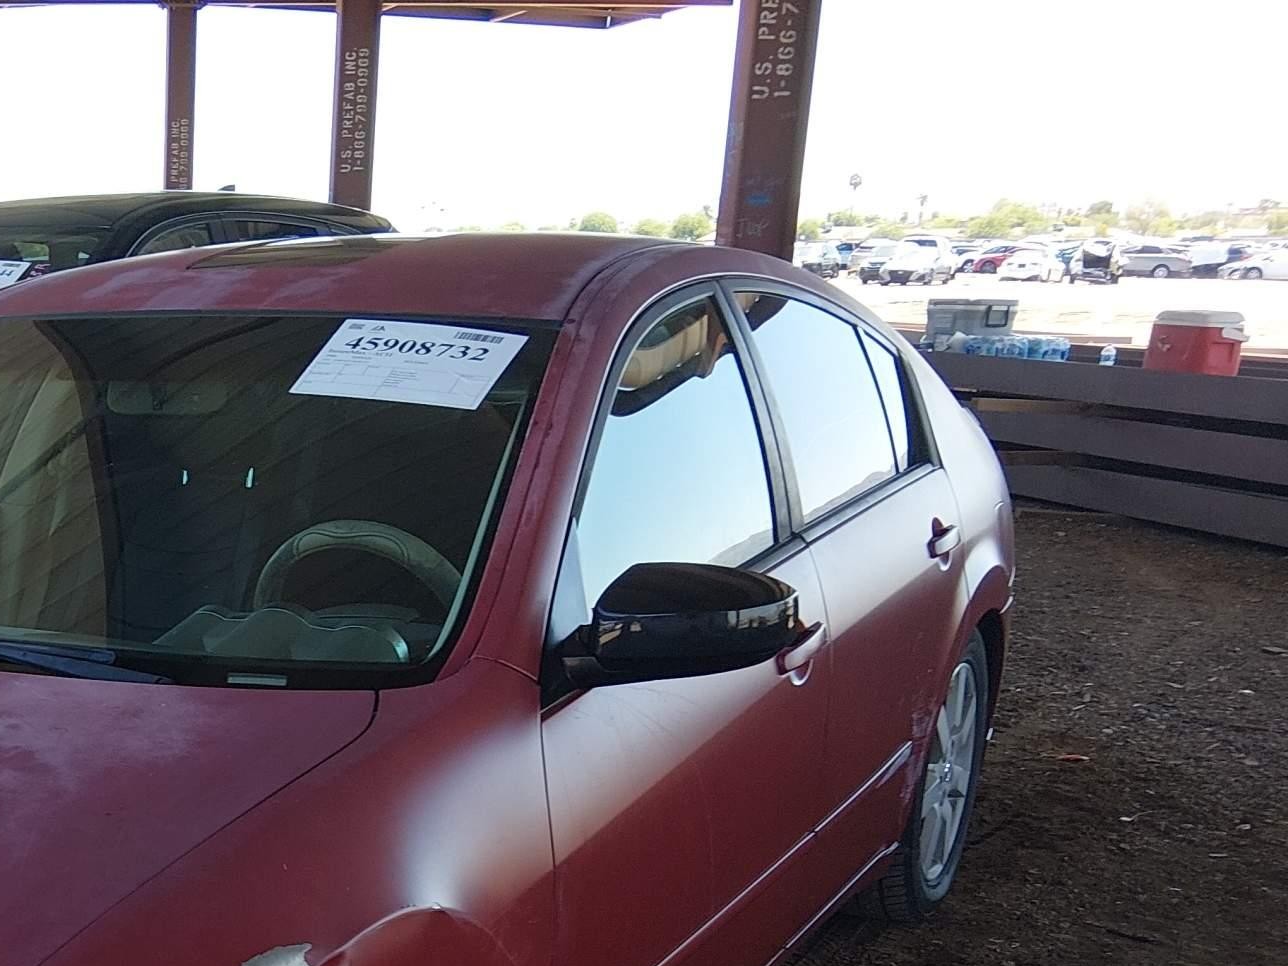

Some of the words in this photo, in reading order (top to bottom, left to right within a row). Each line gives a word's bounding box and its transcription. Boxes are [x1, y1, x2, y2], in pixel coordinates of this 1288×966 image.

[343, 46, 357, 76] INC.
[773, 1, 800, 97] 1-866-7
[751, 55, 775, 100] U.S.
[341, 82, 356, 138] PREFAB
[352, 47, 370, 172] 1-866-799-0909
[170, 142, 180, 183] PREFAB
[339, 145, 354, 173] U.S.
[344, 335, 491, 362] 45908732
